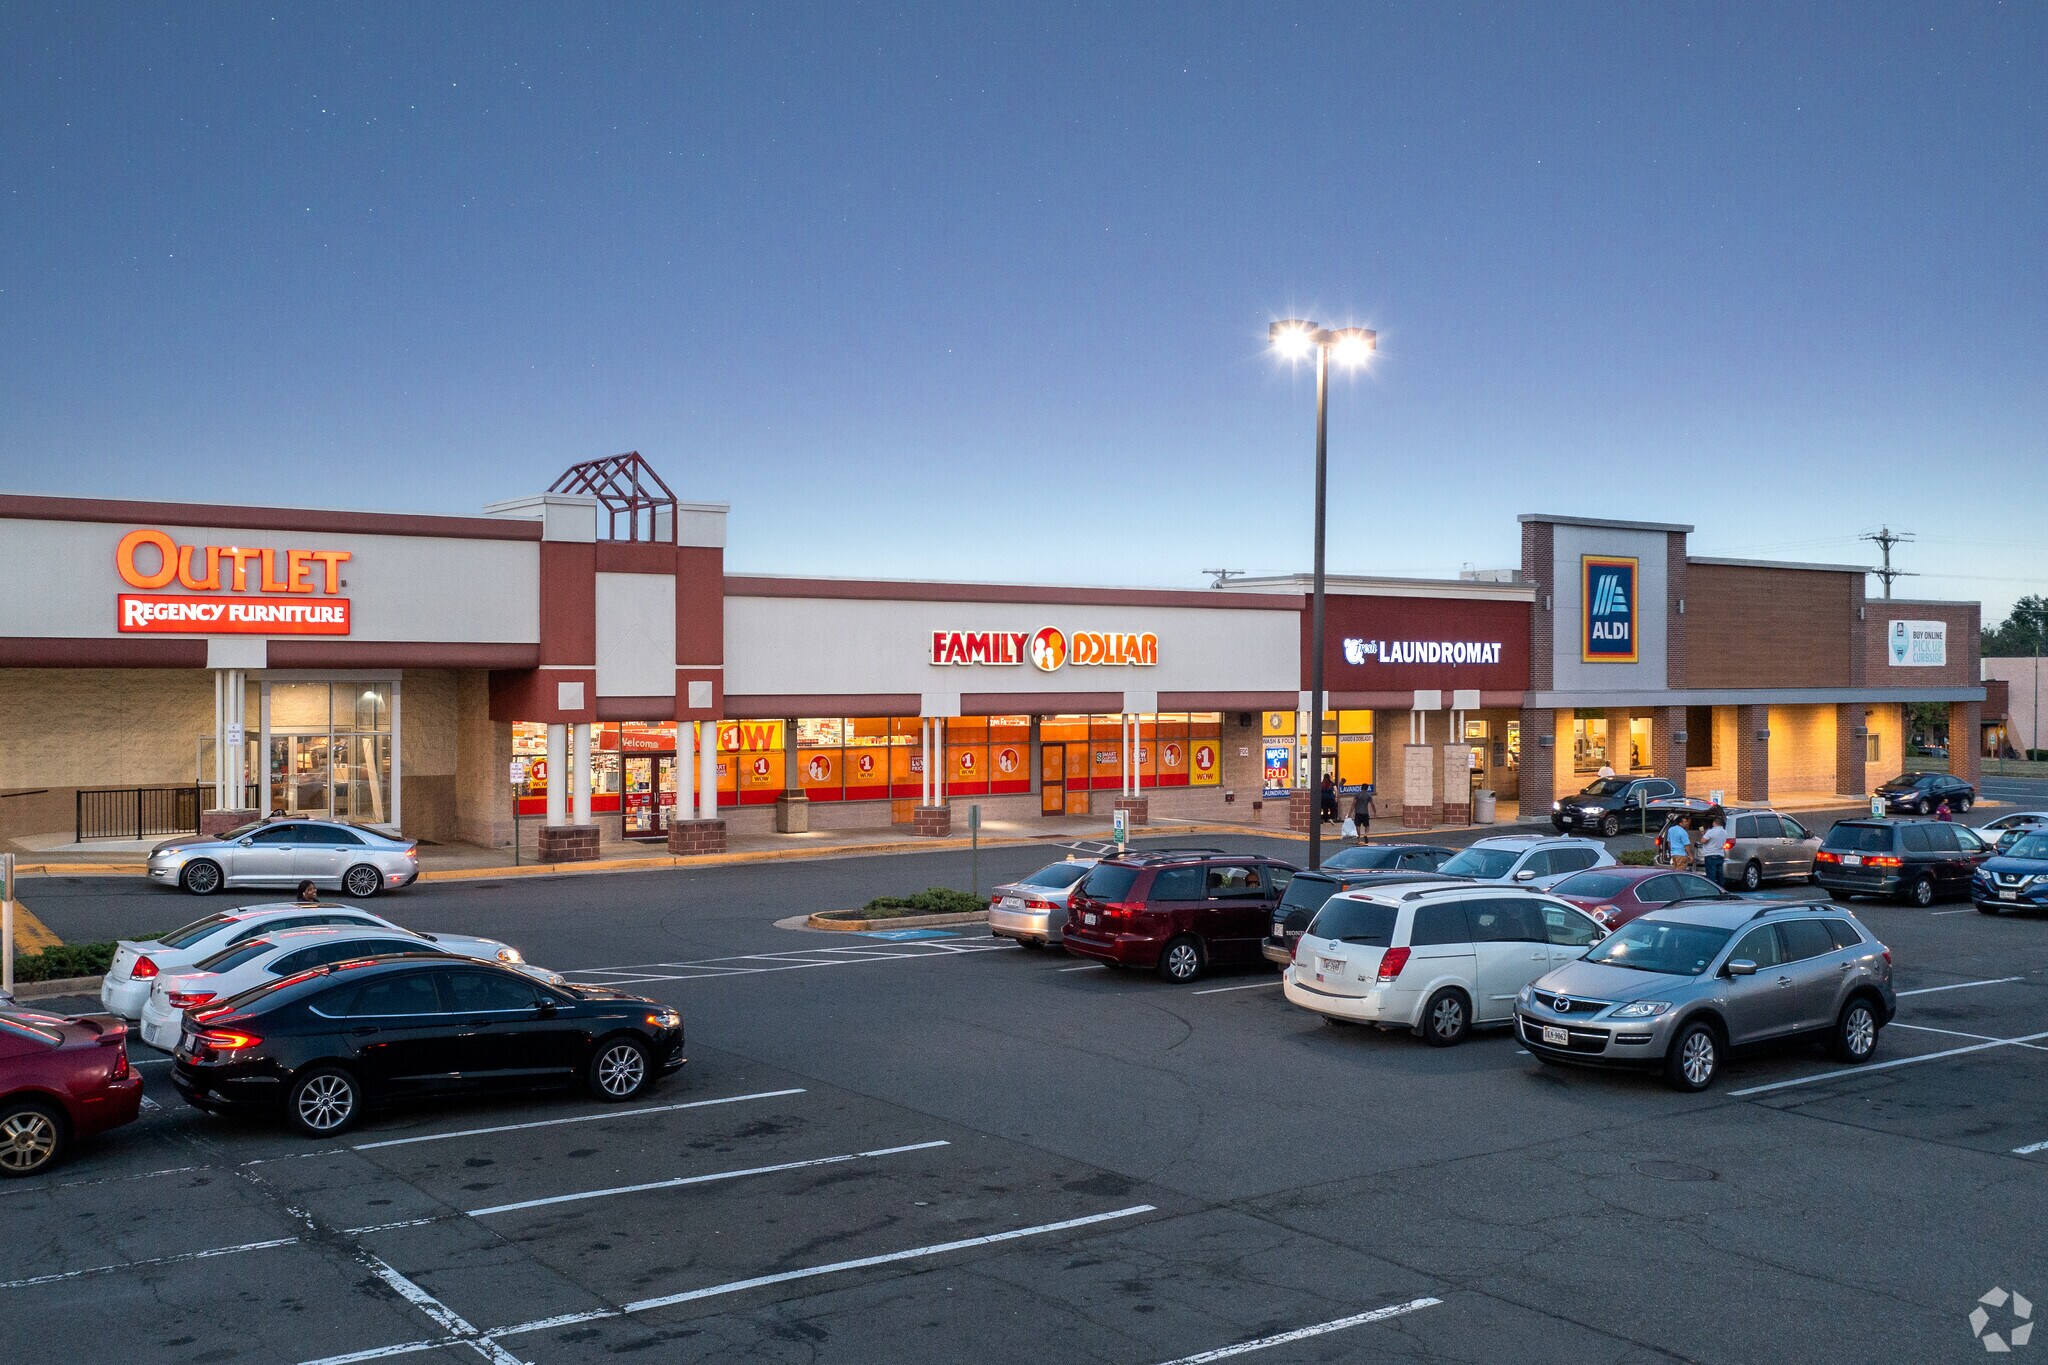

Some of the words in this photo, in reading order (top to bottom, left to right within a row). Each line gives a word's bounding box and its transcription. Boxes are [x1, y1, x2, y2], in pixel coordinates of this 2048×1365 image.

[116, 529, 351, 594] OUTLET
[124, 599, 226, 627] REGENCY
[229, 604, 345, 623] FURNITURE
[1592, 621, 1629, 640] ALDI
[1912, 631, 1924, 640] BUY
[1924, 631, 1943, 640] ONLINE
[933, 631, 1029, 663] FAMILY
[1072, 631, 1158, 664] DOLLAR
[1379, 640, 1502, 664] LAUNDROMAT
[1912, 640, 1931, 652] PICK
[1932, 640, 1943, 652] UP
[1912, 652, 1943, 663] CURBSIDE
[1197, 747, 1211, 767] $1
[1266, 749, 1288, 759] WASH
[533, 762, 547, 779] $1
[1273, 758, 1280, 768] &
[1267, 768, 1288, 778] FOLD
